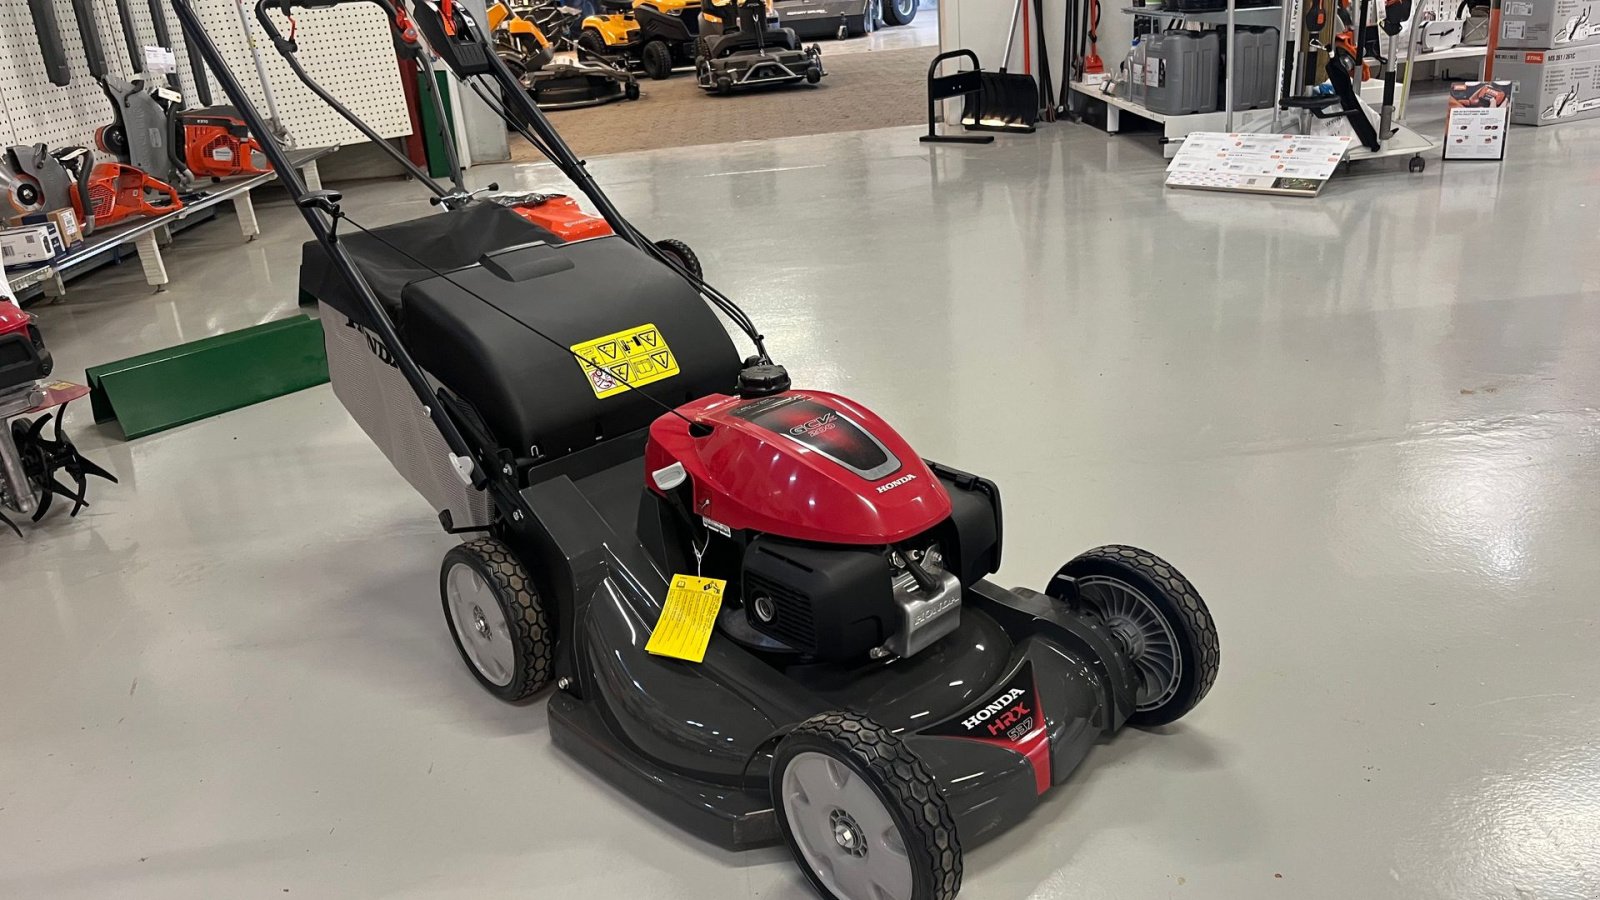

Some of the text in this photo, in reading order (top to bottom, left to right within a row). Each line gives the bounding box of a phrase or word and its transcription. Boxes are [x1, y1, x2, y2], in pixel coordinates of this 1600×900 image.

[876, 473, 917, 494] HONDA
[914, 597, 960, 626] HONDA
[961, 688, 1025, 731] HONDA
[987, 701, 1030, 736] HRX
[1007, 716, 1033, 742] 537
